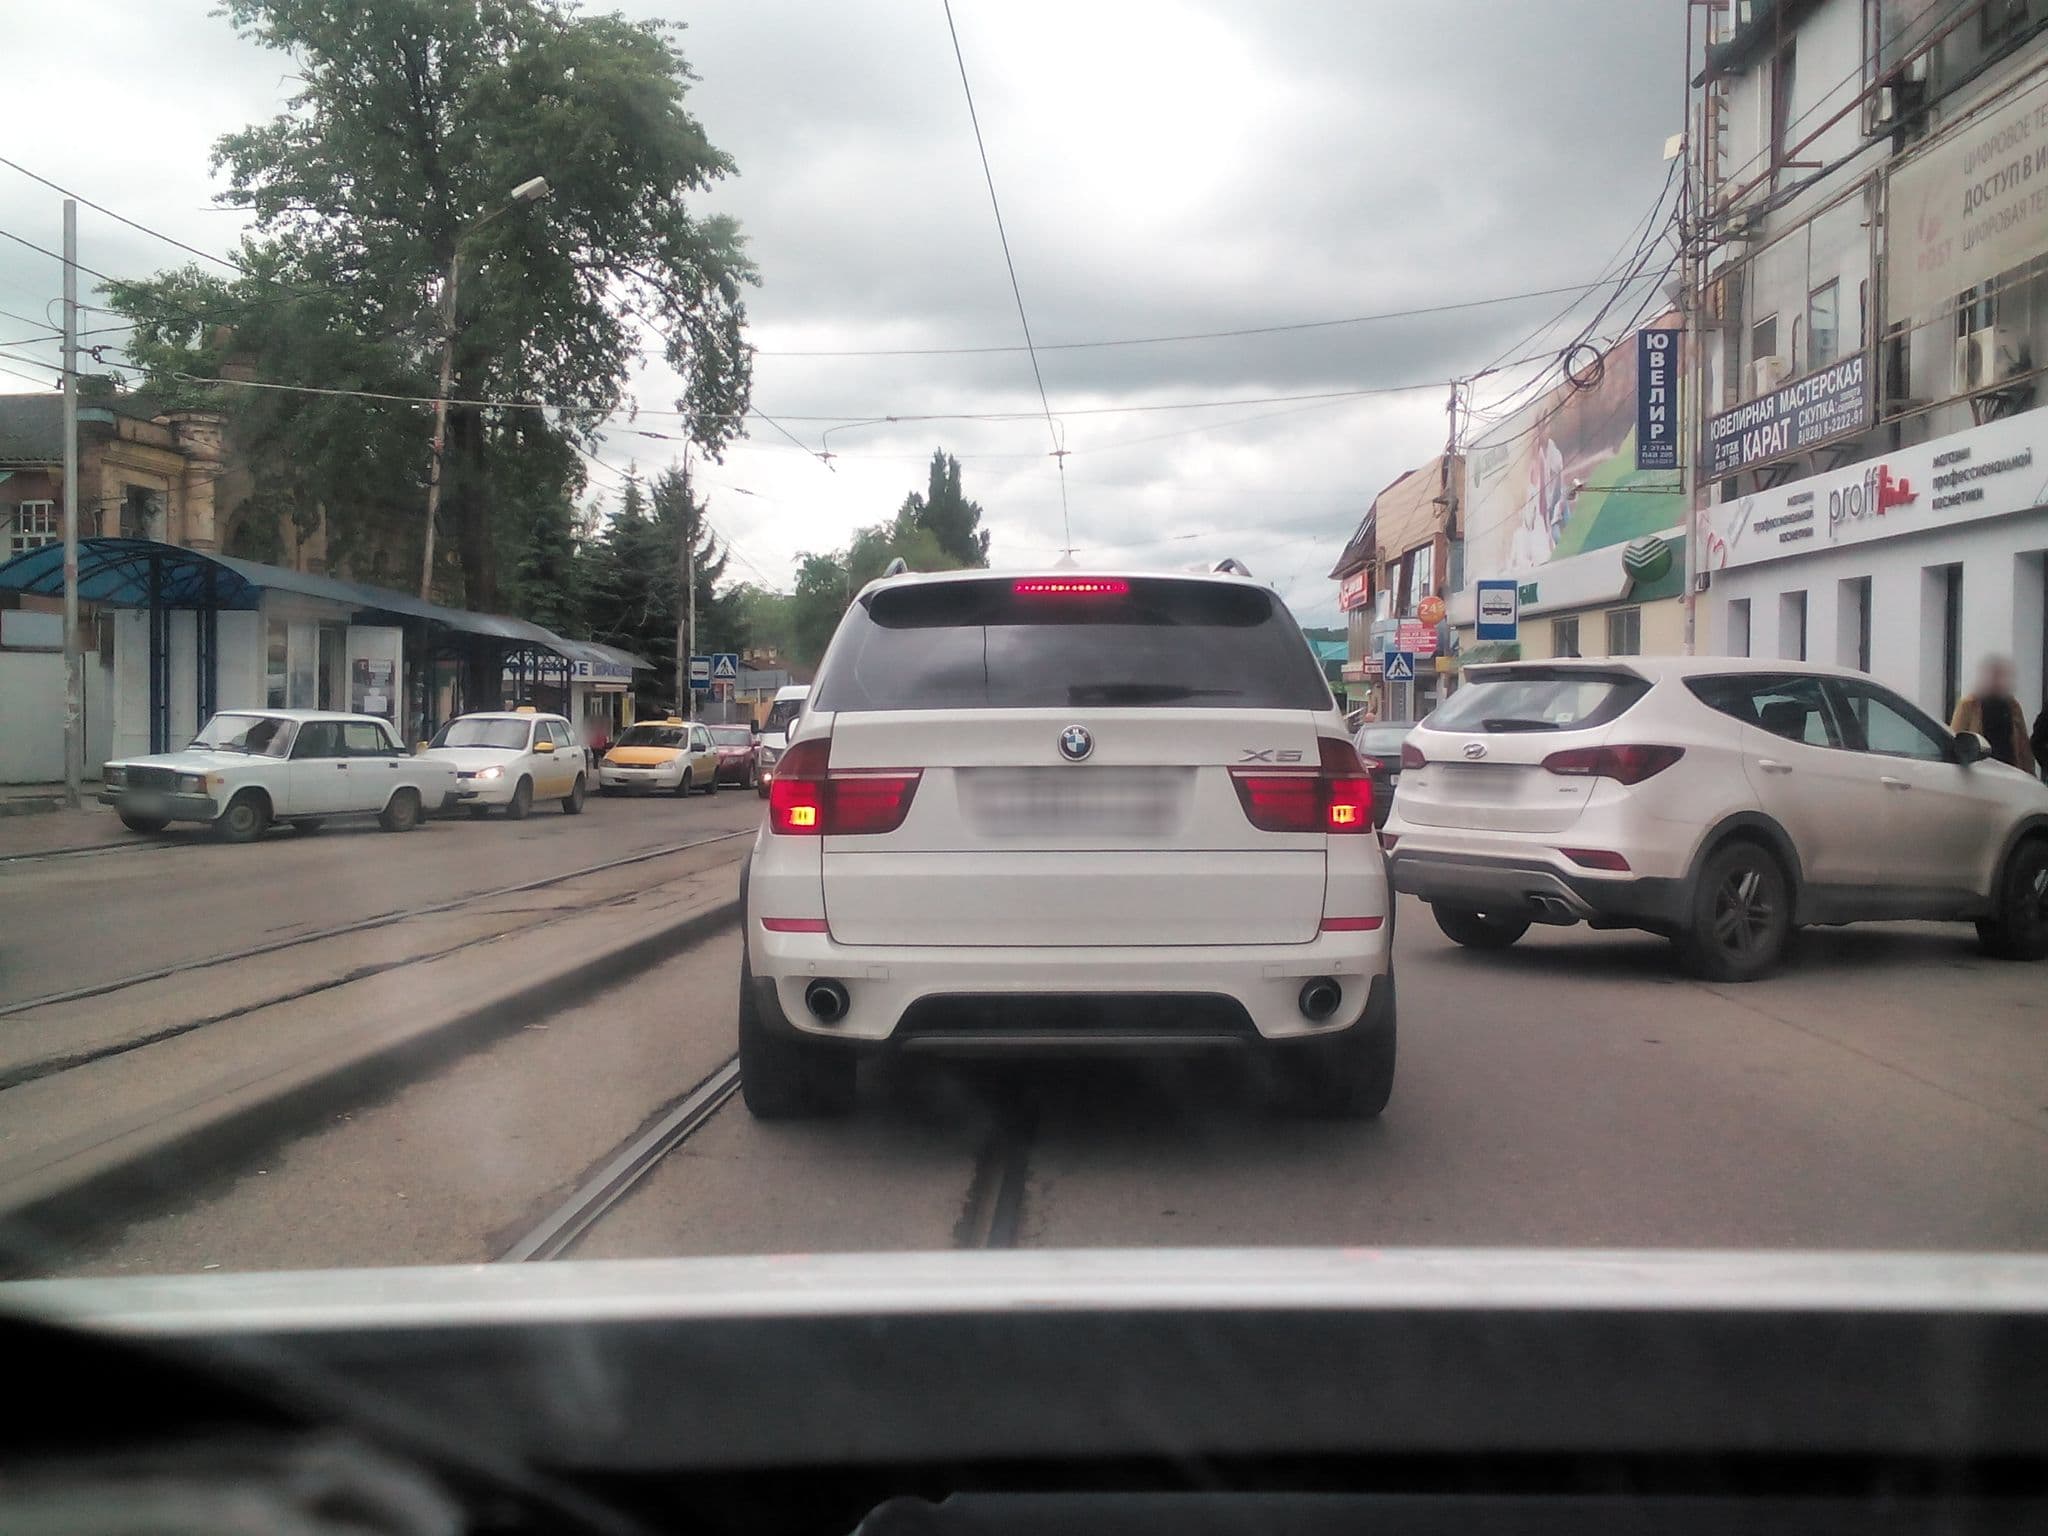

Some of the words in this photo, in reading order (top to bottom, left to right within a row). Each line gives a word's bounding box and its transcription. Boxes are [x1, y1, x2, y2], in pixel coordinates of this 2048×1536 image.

[1963, 161, 2020, 220] ДОСТУП
[2023, 155, 2031, 181] В
[1646, 333, 1670, 440] ЮВЕЛИР
[1710, 396, 1775, 441] ЮВЕЛИРНАЯ
[1779, 358, 1863, 414] МАСТЕРСКАЯ
[1715, 443, 1720, 460] 2
[1743, 417, 1791, 463] КАРАТ
[1238, 749, 1303, 762] X5
